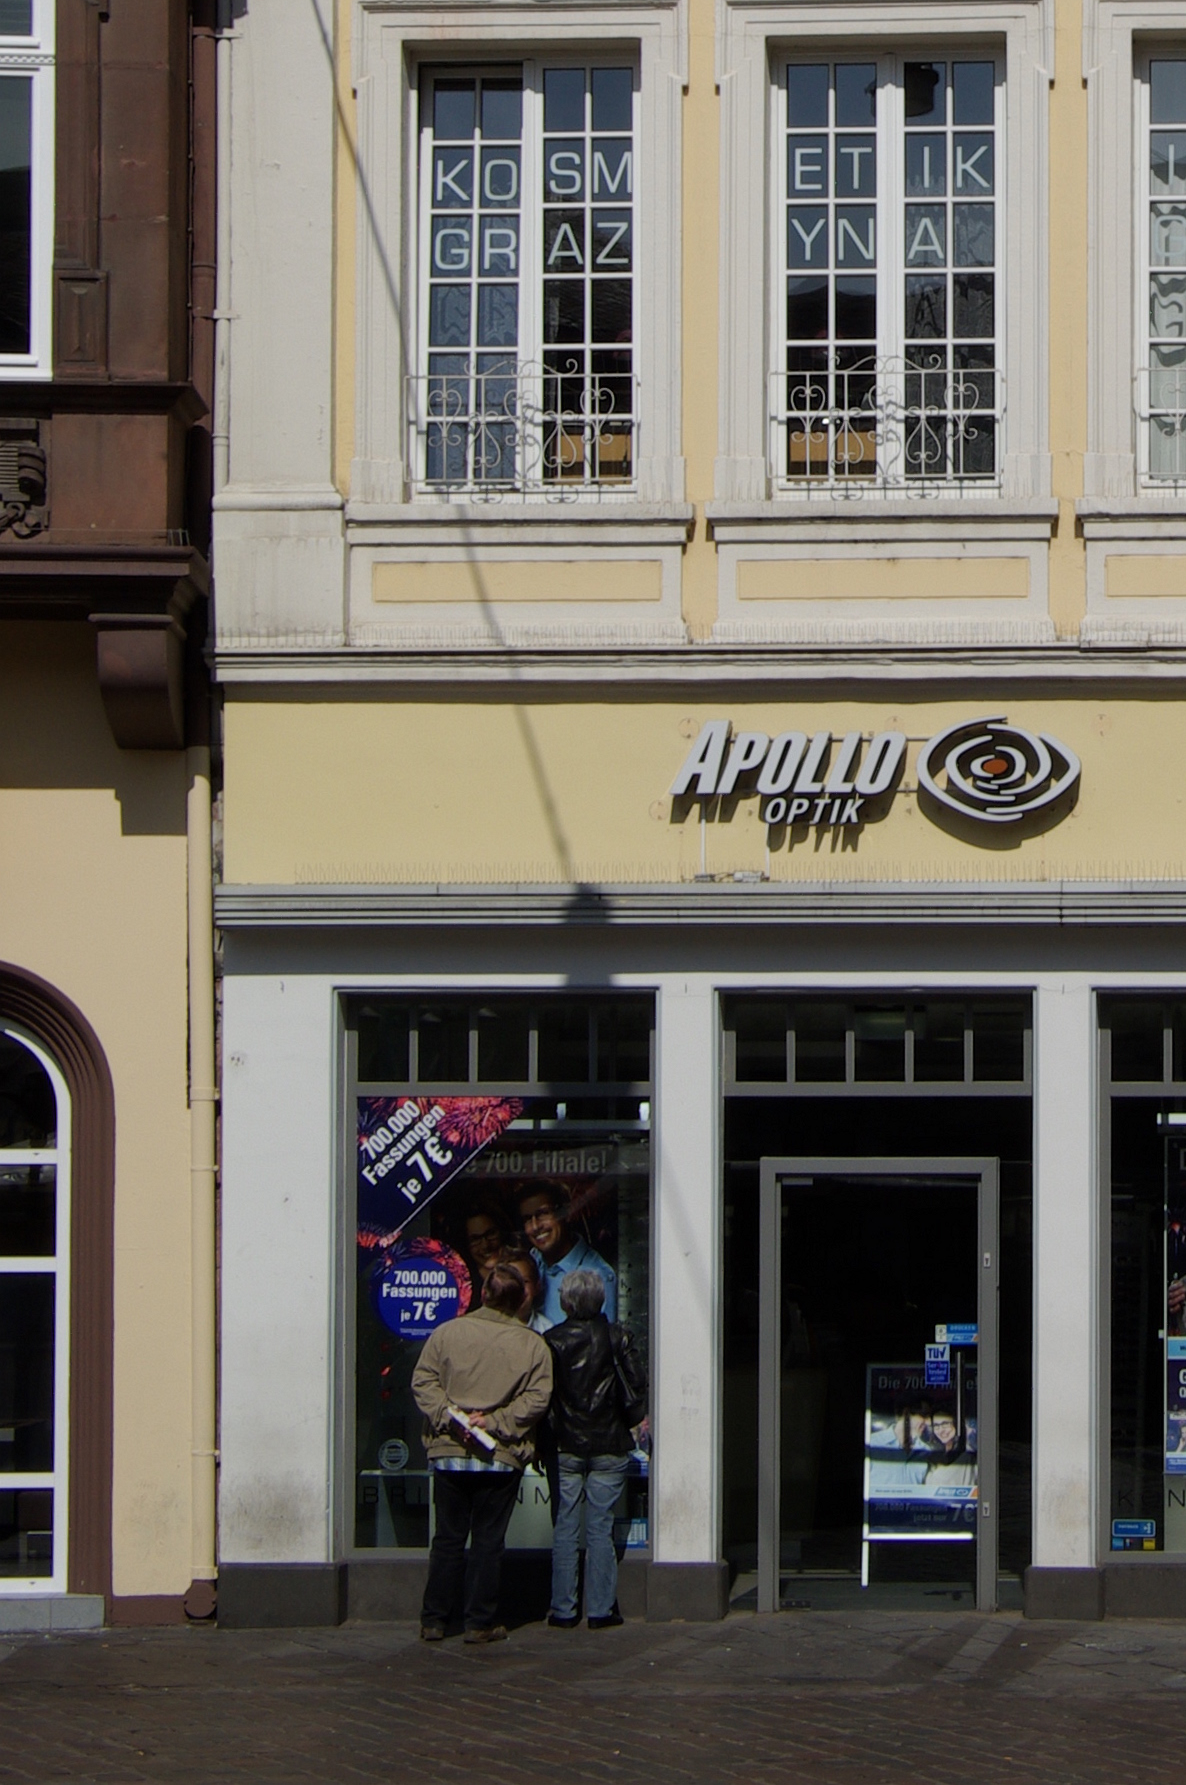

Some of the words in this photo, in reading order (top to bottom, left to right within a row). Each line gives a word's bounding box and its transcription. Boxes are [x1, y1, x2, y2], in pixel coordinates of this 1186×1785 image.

[669, 718, 908, 795] APOLLO
[763, 796, 866, 825] OPTIK
[360, 1099, 421, 1161] 700.000
[361, 1104, 447, 1187] Fassungen
[532, 1149, 607, 1174] Filiale!
[396, 1176, 423, 1205] je
[382, 1283, 457, 1300] Fassungen
[393, 1271, 447, 1285] 700.000
